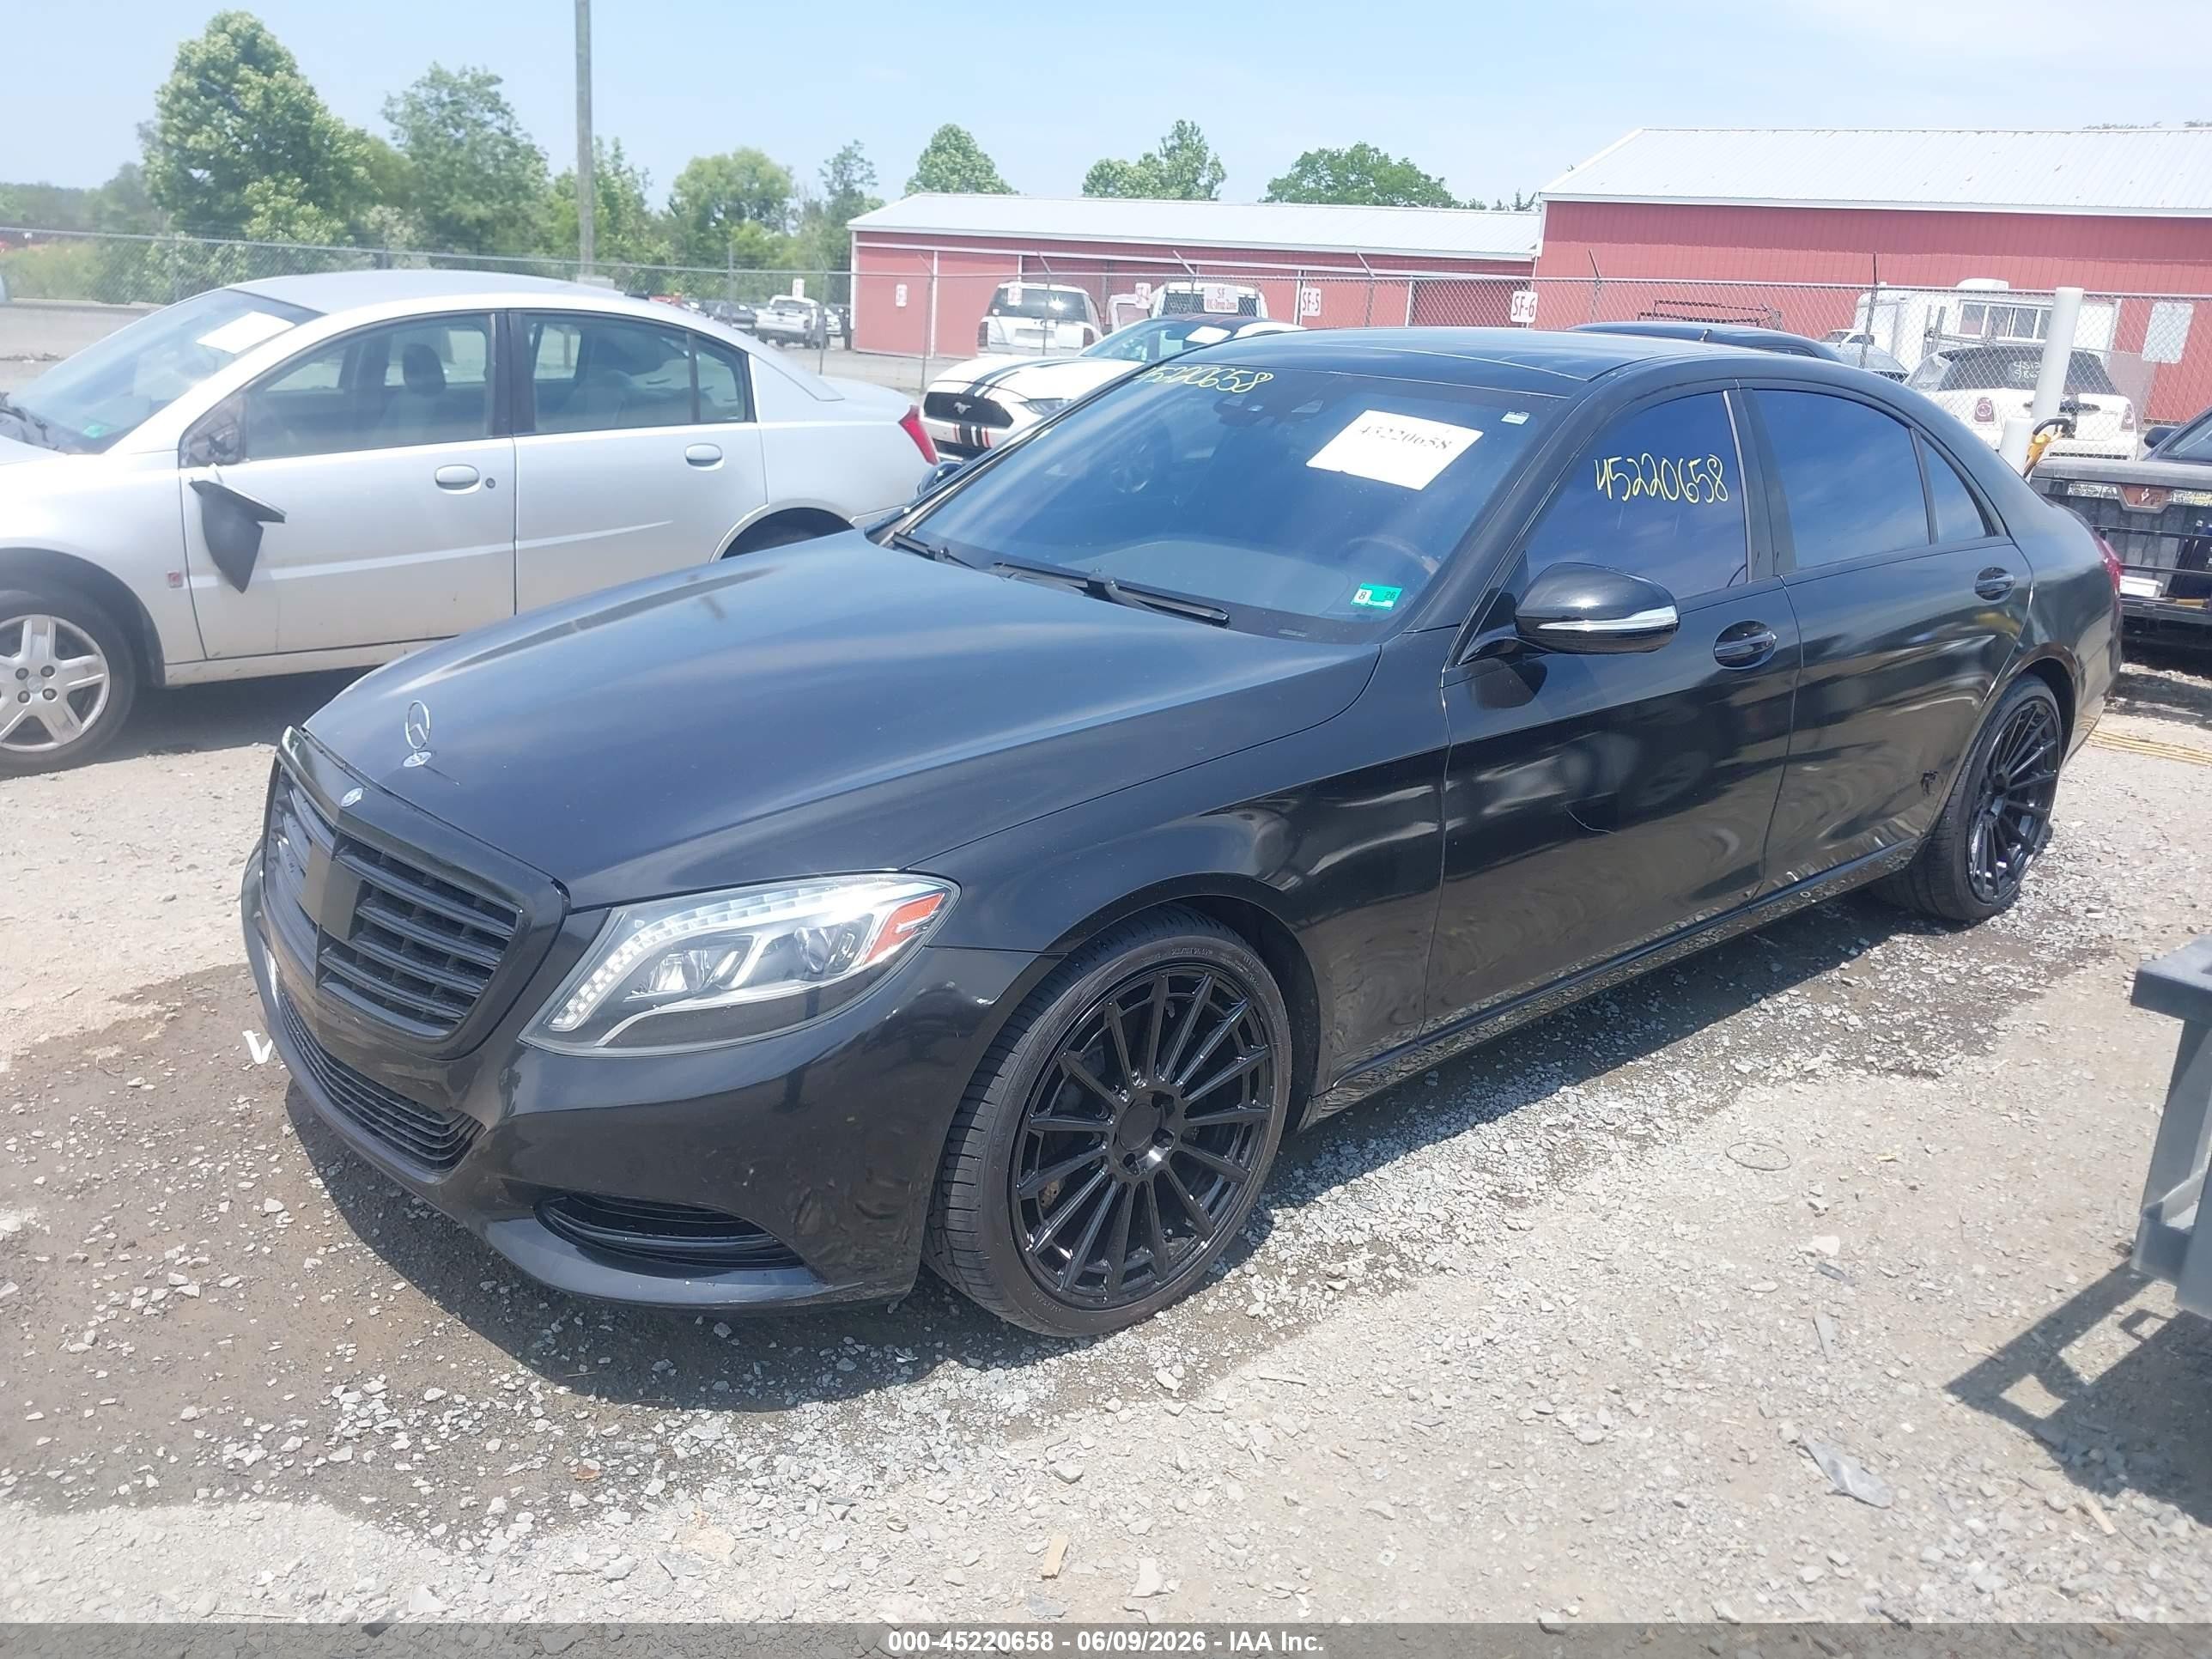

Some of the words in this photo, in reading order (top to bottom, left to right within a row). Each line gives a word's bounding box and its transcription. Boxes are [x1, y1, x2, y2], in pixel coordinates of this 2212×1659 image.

[1303, 292, 1320, 311] SF-5
[1512, 295, 1536, 318] SF-6
[1594, 453, 1729, 504] 45220658
[1358, 591, 1368, 600] 8
